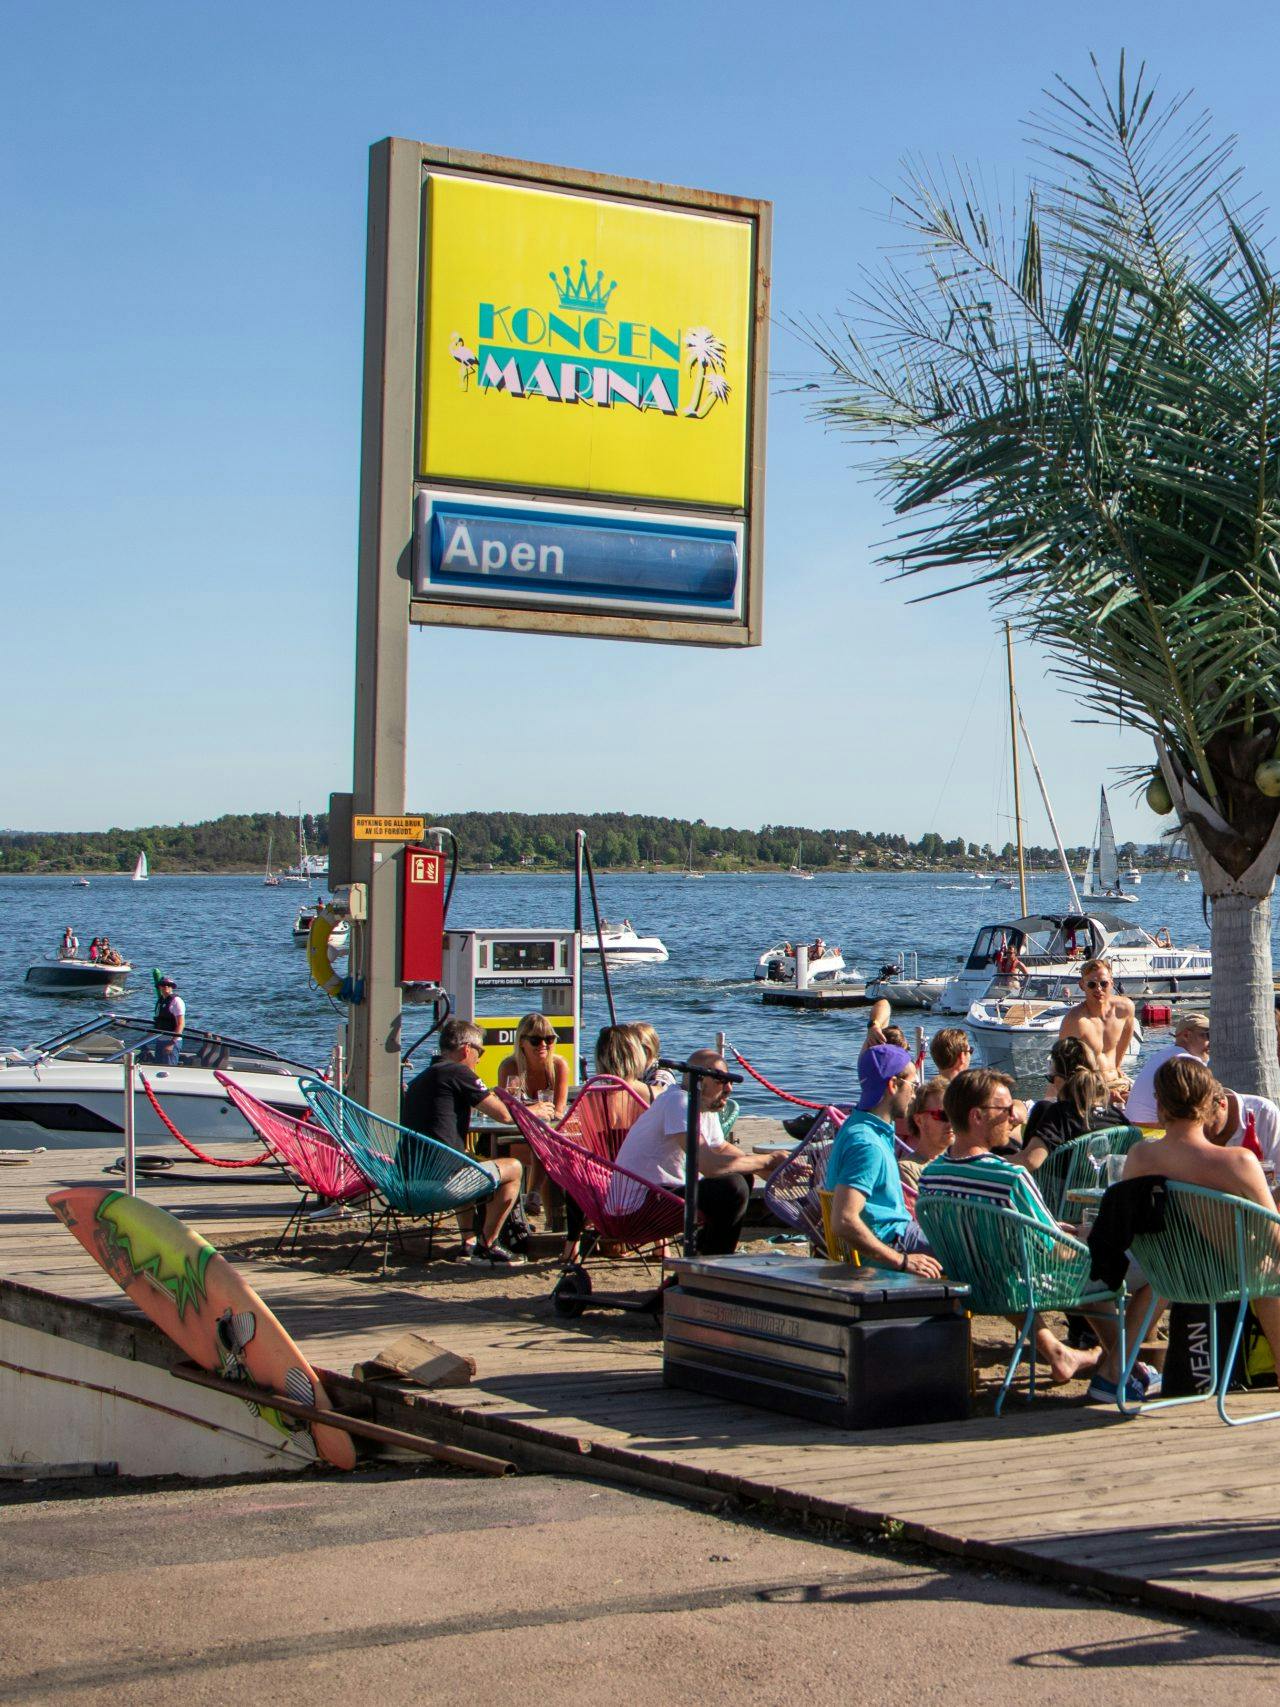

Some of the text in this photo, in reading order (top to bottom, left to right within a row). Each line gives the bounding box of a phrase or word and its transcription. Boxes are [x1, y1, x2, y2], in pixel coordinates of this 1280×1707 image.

[479, 302, 681, 363] KONGEN
[479, 352, 678, 416] MARINA
[444, 520, 564, 574] Åpen
[365, 827, 372, 835] AV
[393, 819, 404, 827] ALL
[460, 935, 468, 952] 7
